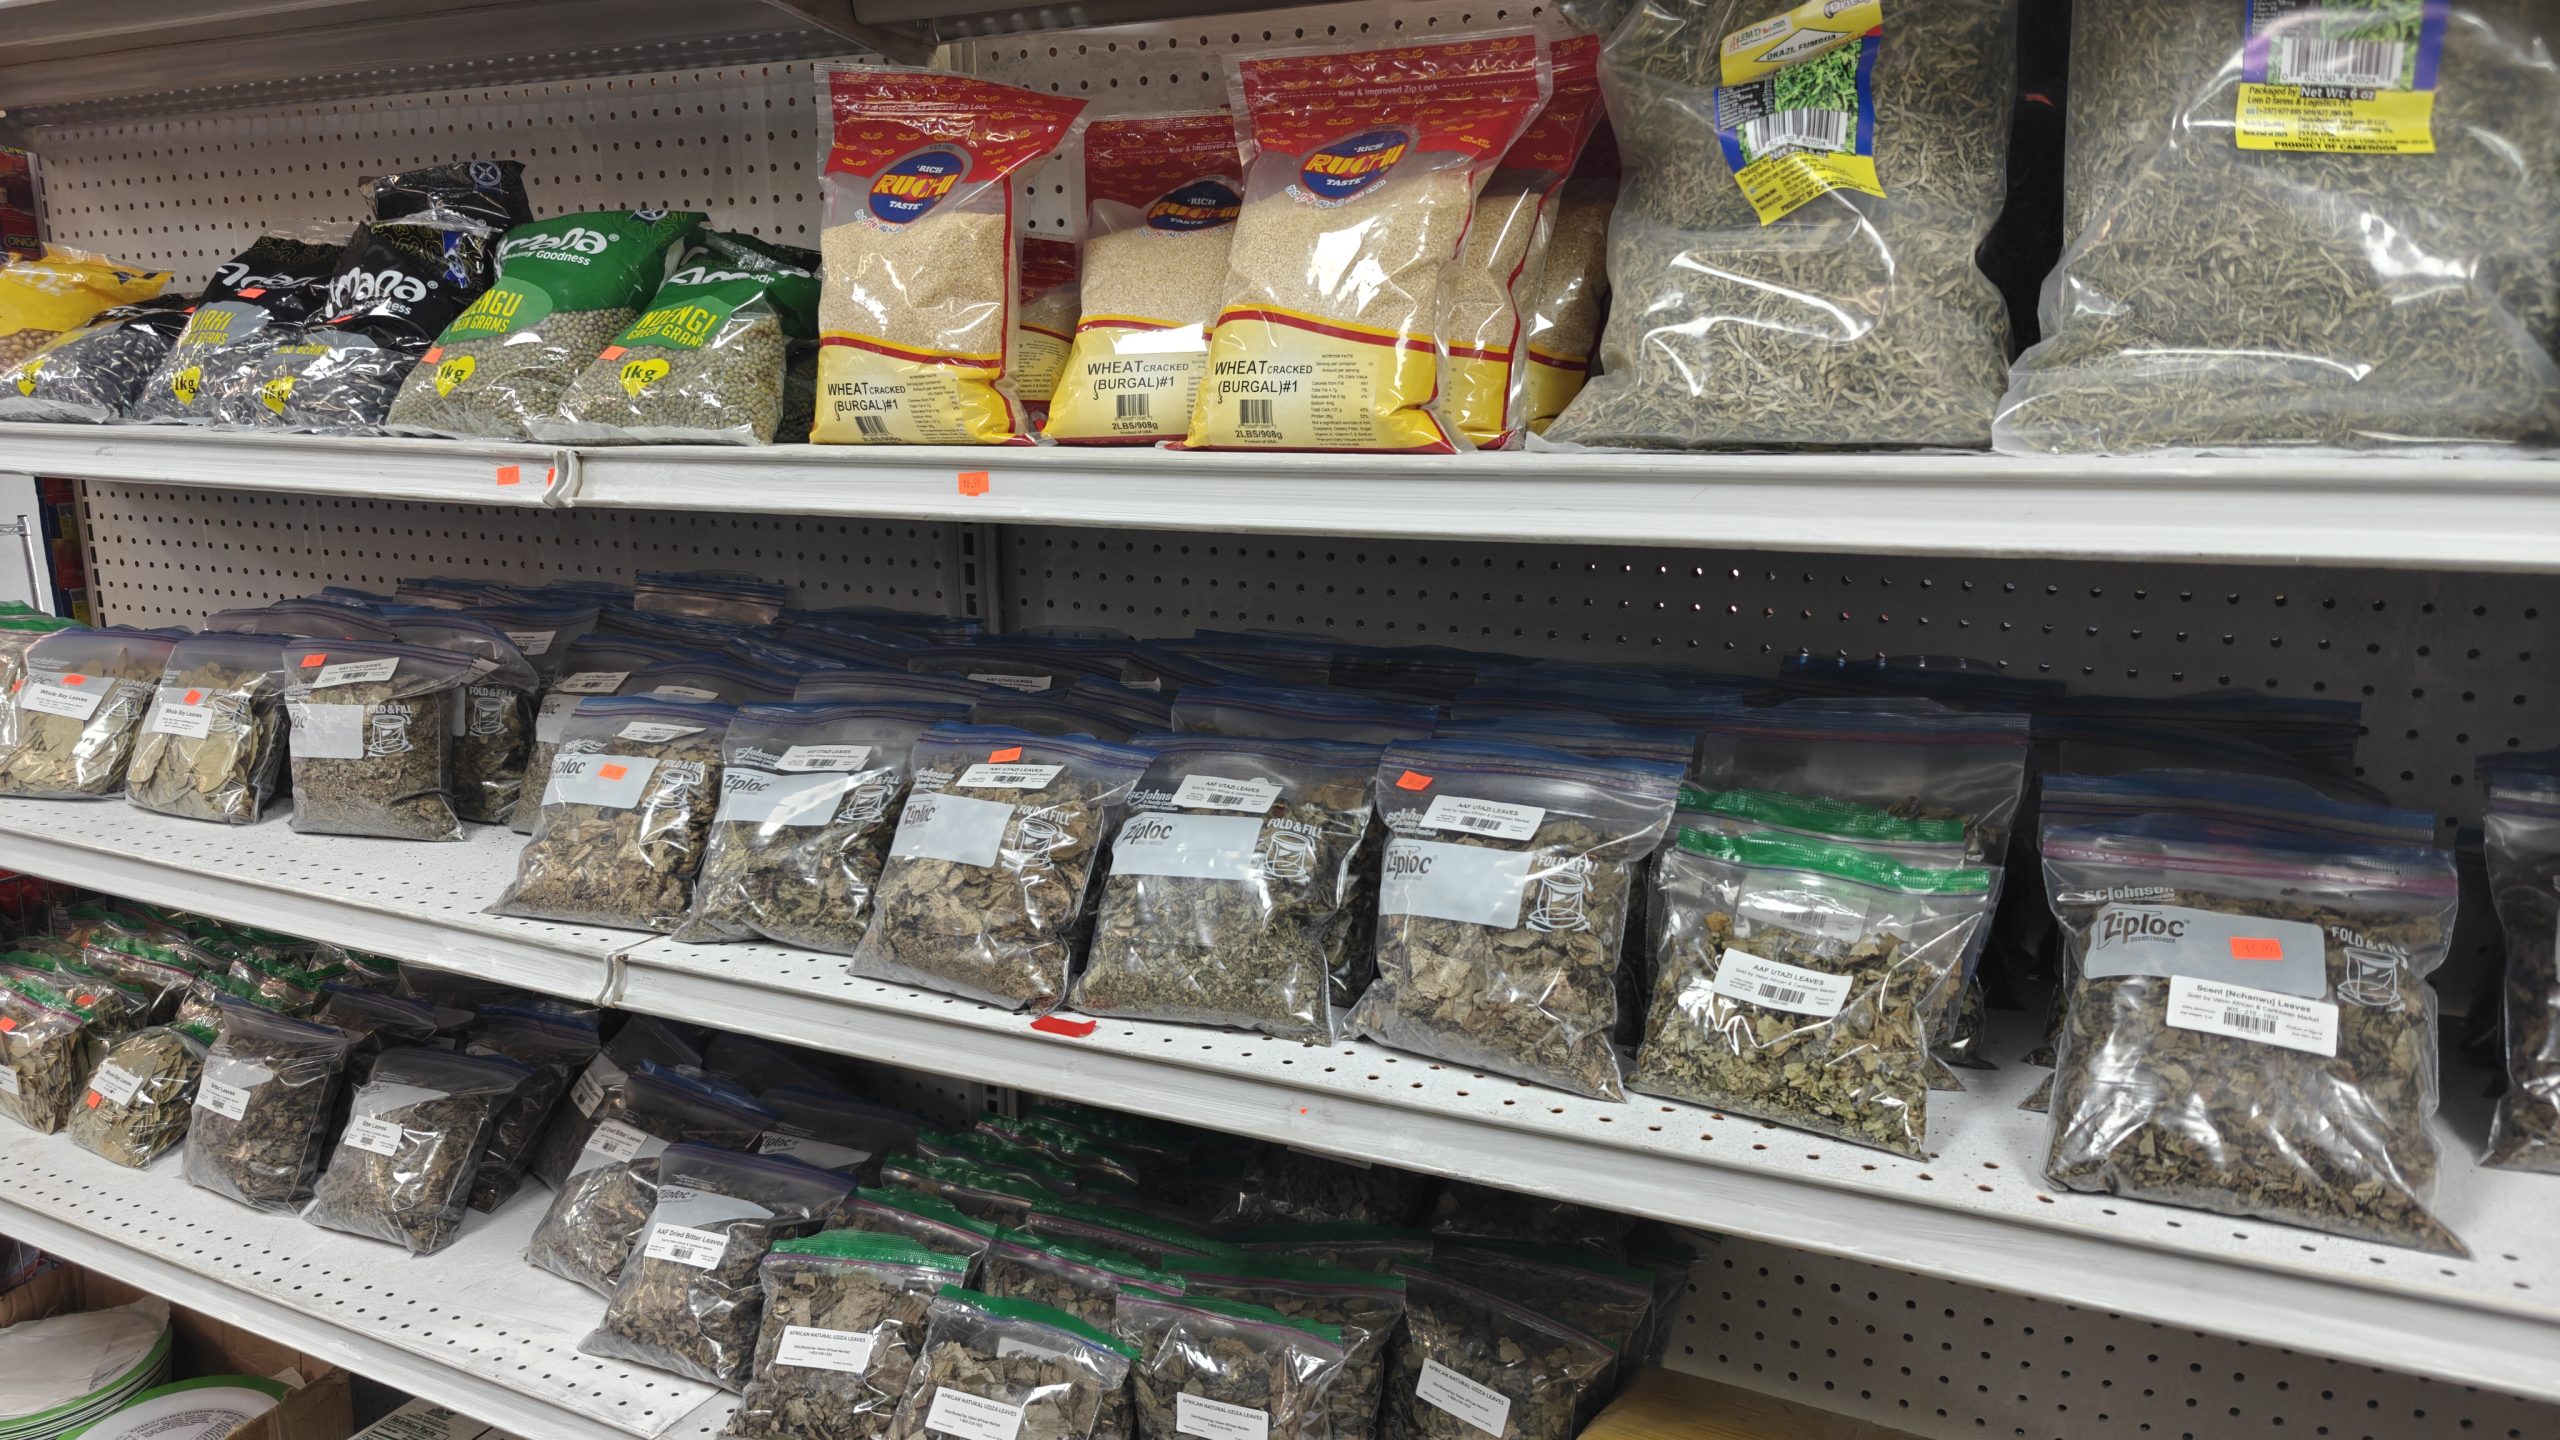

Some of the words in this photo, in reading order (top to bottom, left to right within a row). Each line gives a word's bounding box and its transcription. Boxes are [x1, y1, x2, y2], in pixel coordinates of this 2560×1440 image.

[1357, 88, 1363, 96] &
[1364, 87, 1401, 96] Improved
[1404, 85, 1416, 94] Zip
[2301, 87, 2322, 98] Net
[2349, 89, 2357, 99] 6
[1305, 144, 1406, 175] RUCHI
[874, 173, 958, 199] RUCHI
[536, 249, 591, 266] Goodness
[471, 315, 510, 333] GRAMS
[439, 362, 466, 384] 1kg
[624, 363, 657, 383] 1kg
[1087, 360, 1144, 376] WHEAT
[1143, 363, 1189, 373] CRACKED
[1215, 360, 1268, 375] WHEAT
[1267, 364, 1313, 374] CRACKED
[175, 375, 199, 394] 1kg
[827, 382, 869, 396] WHEAT
[869, 385, 906, 395] CRACKED
[1093, 376, 1175, 395] (BURGAL)#1
[1217, 380, 1298, 396] (BURGAL)#1
[834, 400, 899, 417] (BURGAL)#1
[1112, 421, 1159, 430] 2LBS/908g
[1235, 430, 1283, 439] 2LBS/908g
[58, 691, 68, 700] Bay
[69, 694, 88, 703] Leaves
[469, 686, 486, 697] FOLD
[488, 687, 495, 697] &
[495, 687, 513, 698] FILL
[186, 710, 203, 719] Leaves
[366, 704, 385, 714] FOLD
[387, 705, 395, 714] &
[395, 704, 413, 715] FILL
[662, 759, 682, 768] FOLD
[724, 774, 771, 794] Ziploc
[884, 776, 900, 785] FILL
[1218, 782, 1236, 790] UTAZI
[1236, 785, 1260, 793] LEAVES
[1017, 805, 1040, 818] FOLD
[1049, 809, 1071, 826] FILL
[1472, 804, 1492, 812] UTAZI
[1492, 807, 1518, 816] LEAVES
[1122, 820, 1173, 845] Ziploc
[1267, 817, 1293, 832] FOLD
[1293, 821, 1301, 832] &
[1301, 822, 1323, 839] FILL
[1386, 849, 1432, 881] Ziploc
[1537, 854, 1564, 869] FOLD
[2103, 911, 2185, 945] Ziploc
[2331, 926, 2364, 948] FOLD
[1753, 964, 1770, 972] AAF
[1770, 968, 1794, 979] UTAZI
[1794, 975, 1825, 986] LEAVES
[2197, 984, 2223, 995] Scent
[2277, 999, 2311, 1013] Leaves
[2187, 992, 2202, 1000] Sold
[2232, 1000, 2255, 1009] African
[2262, 1006, 2295, 1018] Caribbean
[2297, 1013, 2320, 1023] Market
[669, 1230, 685, 1238] Dried
[685, 1233, 702, 1241] Bitter
[702, 1236, 724, 1246] Leaves
[941, 1392, 961, 1402] AFRICAN
[961, 1397, 983, 1409] NATURAL
[998, 1407, 1017, 1417] LEAVES
